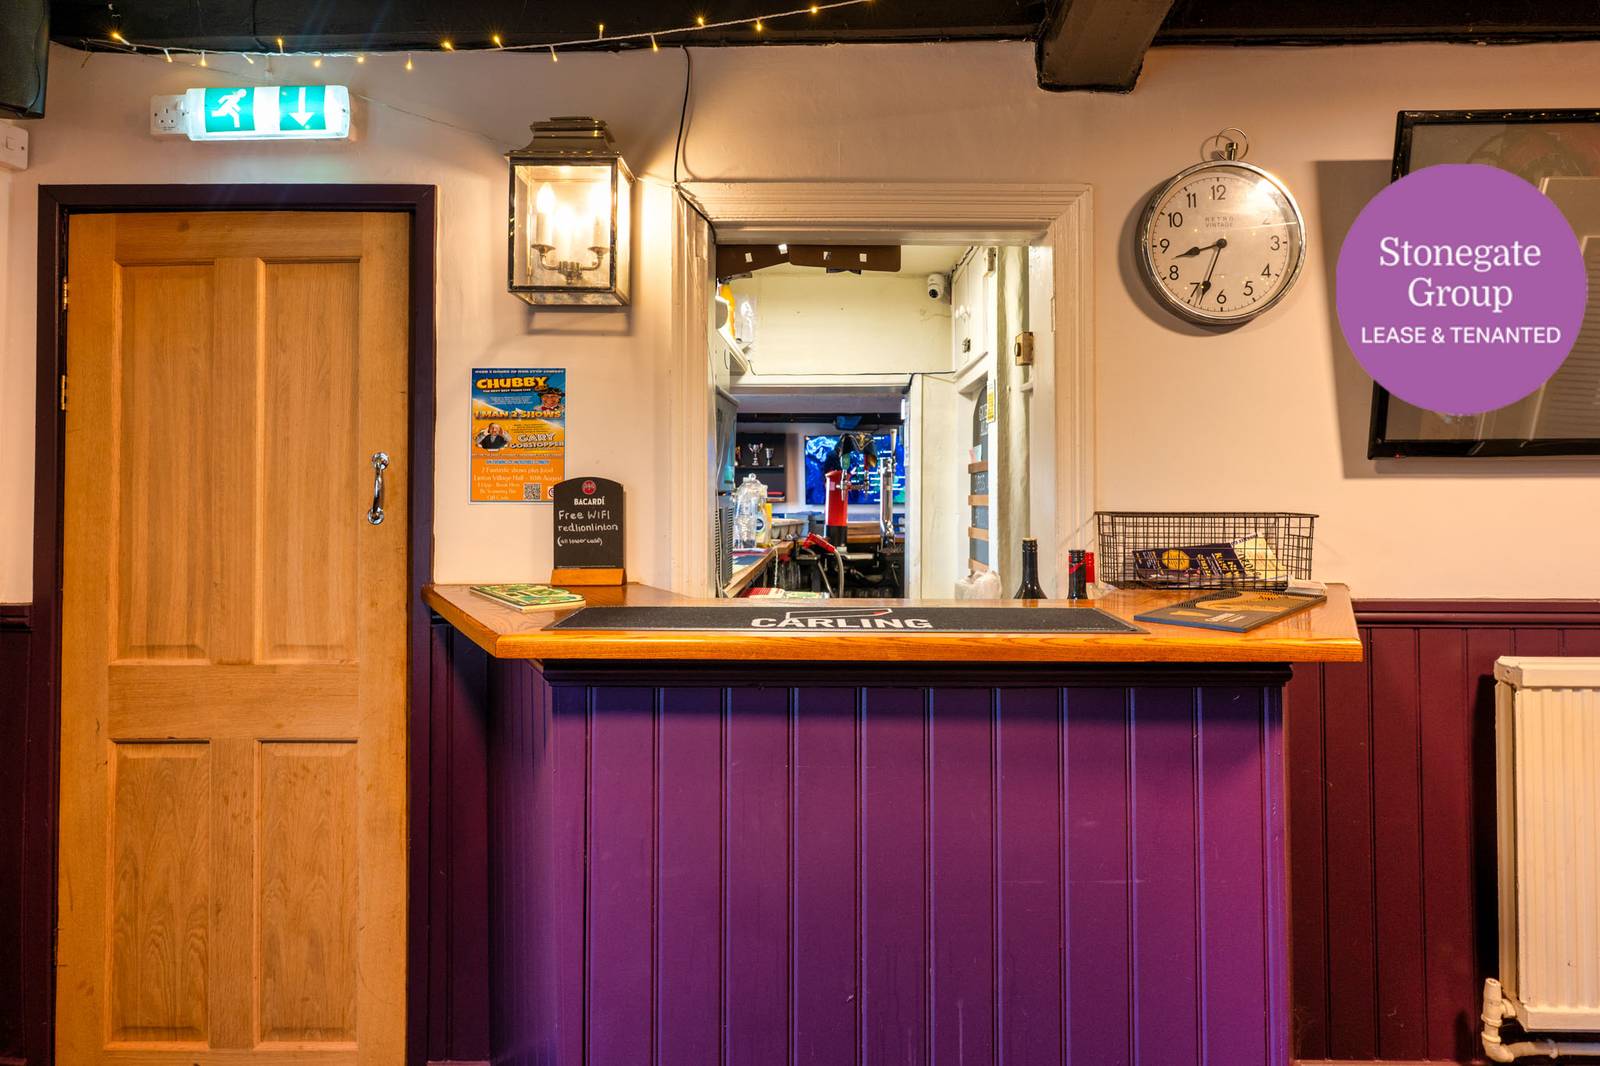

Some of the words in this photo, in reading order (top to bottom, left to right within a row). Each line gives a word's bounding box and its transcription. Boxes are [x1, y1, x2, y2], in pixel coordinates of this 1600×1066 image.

[1211, 185, 1226, 200] 12
[1186, 193, 1196, 208] 11
[1168, 212, 1183, 227] 10
[1159, 238, 1170, 254] 9
[1270, 235, 1280, 251] 3
[1169, 265, 1179, 281] 8
[1261, 264, 1271, 278] 4
[1190, 282, 1200, 298] 7
[1243, 281, 1254, 296] 5
[1216, 289, 1227, 304] 6
[476, 376, 547, 389] CHUBBY
[480, 410, 509, 418] MAN
[521, 410, 561, 418] SHOWS
[517, 432, 555, 442] GARY
[573, 496, 605, 506] BACARDÍ
[558, 510, 584, 520] Free
[558, 523, 618, 532] redlionlinton
[751, 618, 933, 629] CARLING
